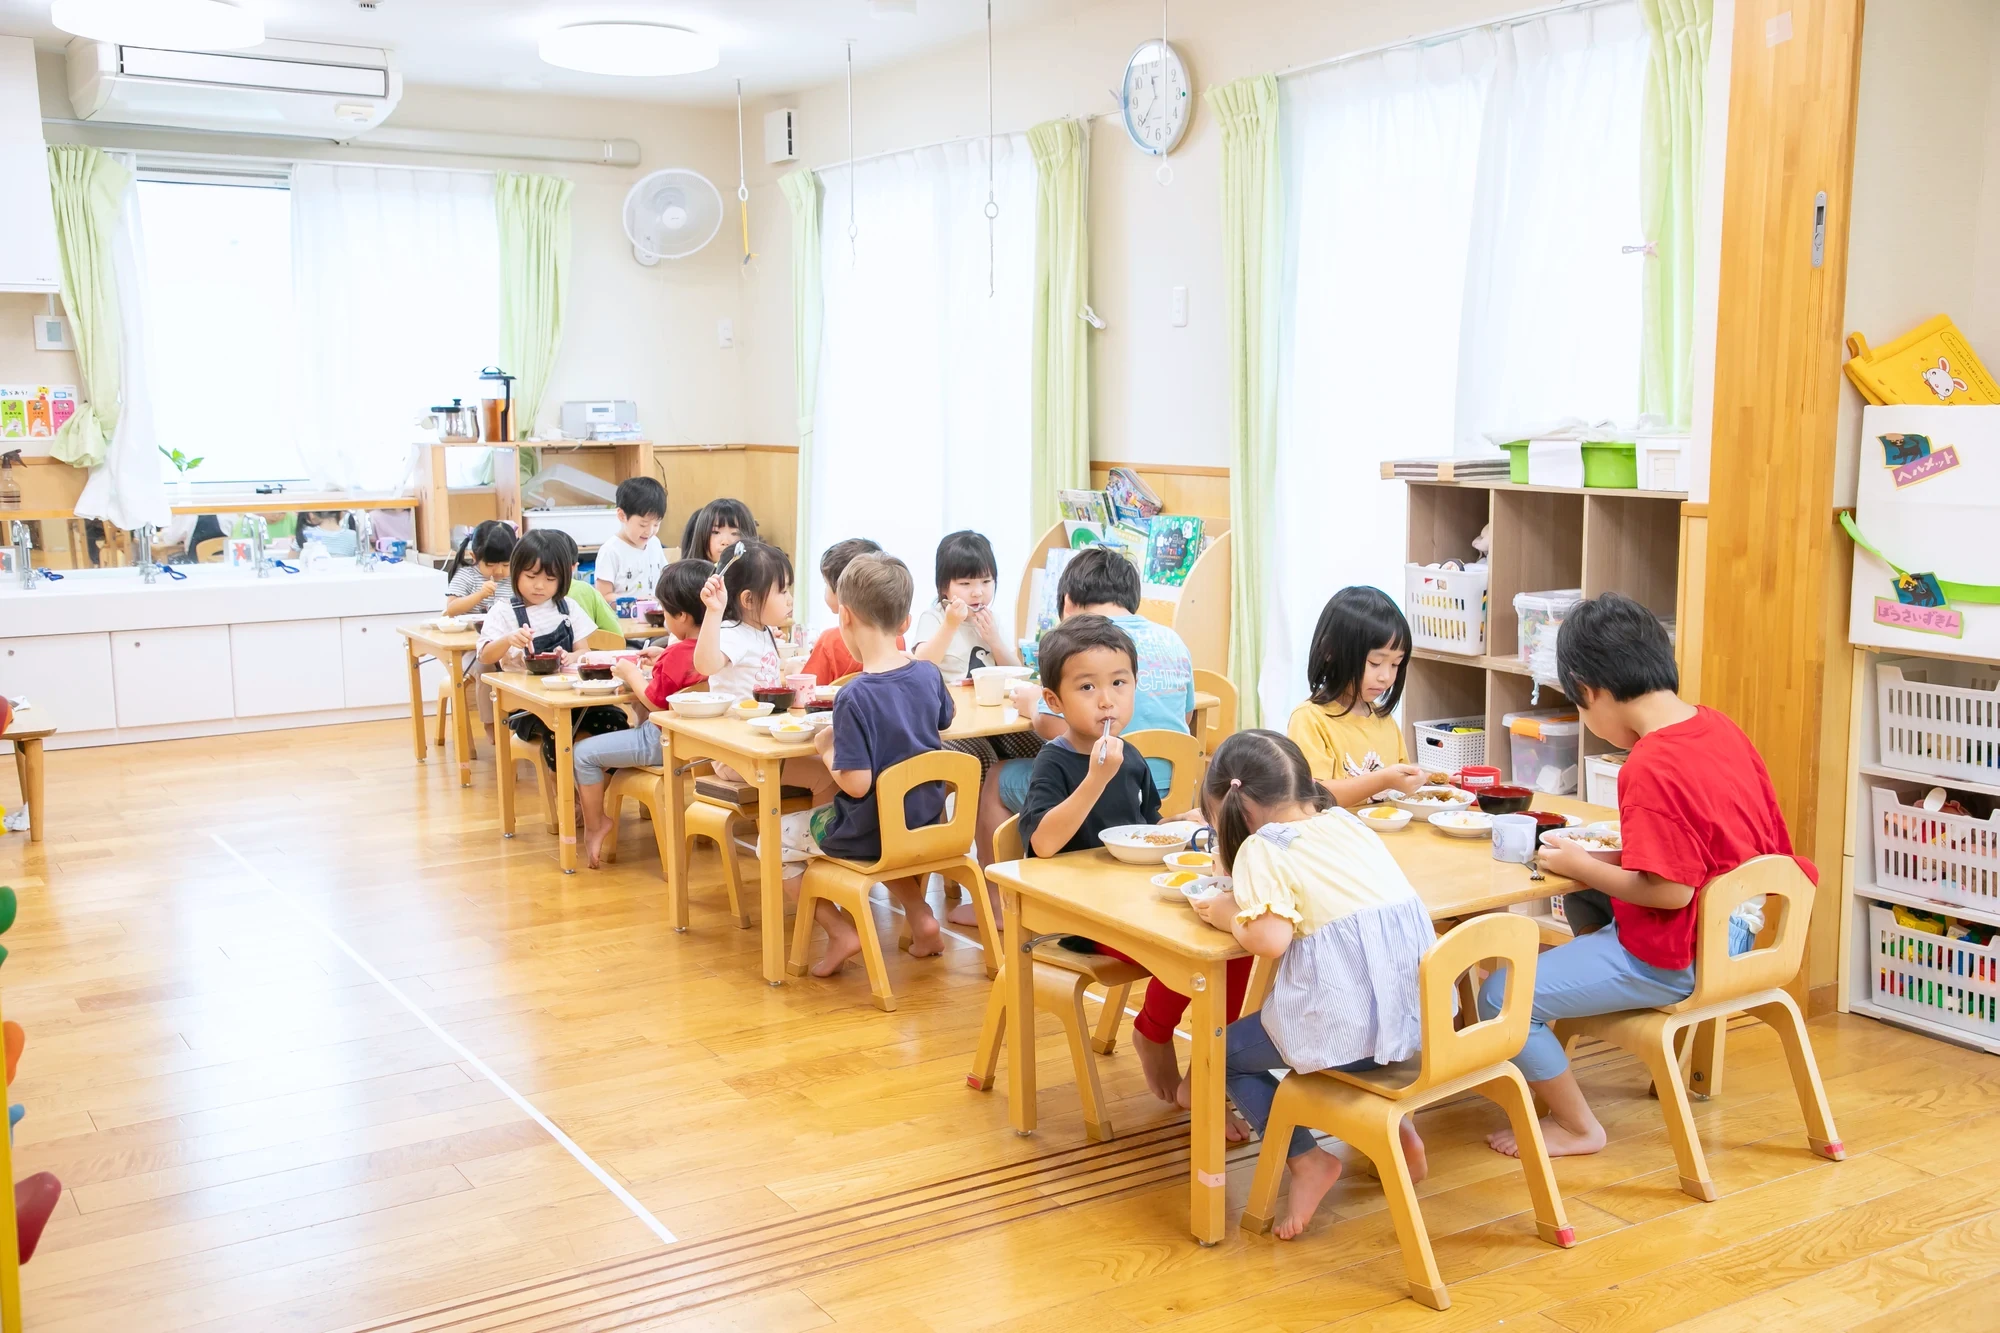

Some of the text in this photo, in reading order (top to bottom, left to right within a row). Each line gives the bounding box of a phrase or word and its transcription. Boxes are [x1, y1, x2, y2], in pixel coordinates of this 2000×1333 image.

[1171, 69, 1177, 83] 2
[1134, 77, 1143, 90] 10
[1175, 87, 1182, 100] 3
[1132, 97, 1139, 109] 9
[1172, 106, 1178, 119] 4
[1137, 114, 1144, 127] 8
[1145, 126, 1151, 139] 7
[1155, 128, 1161, 141] 6
[1166, 122, 1172, 136] 5
[1897, 451, 1953, 482] ヘルメット
